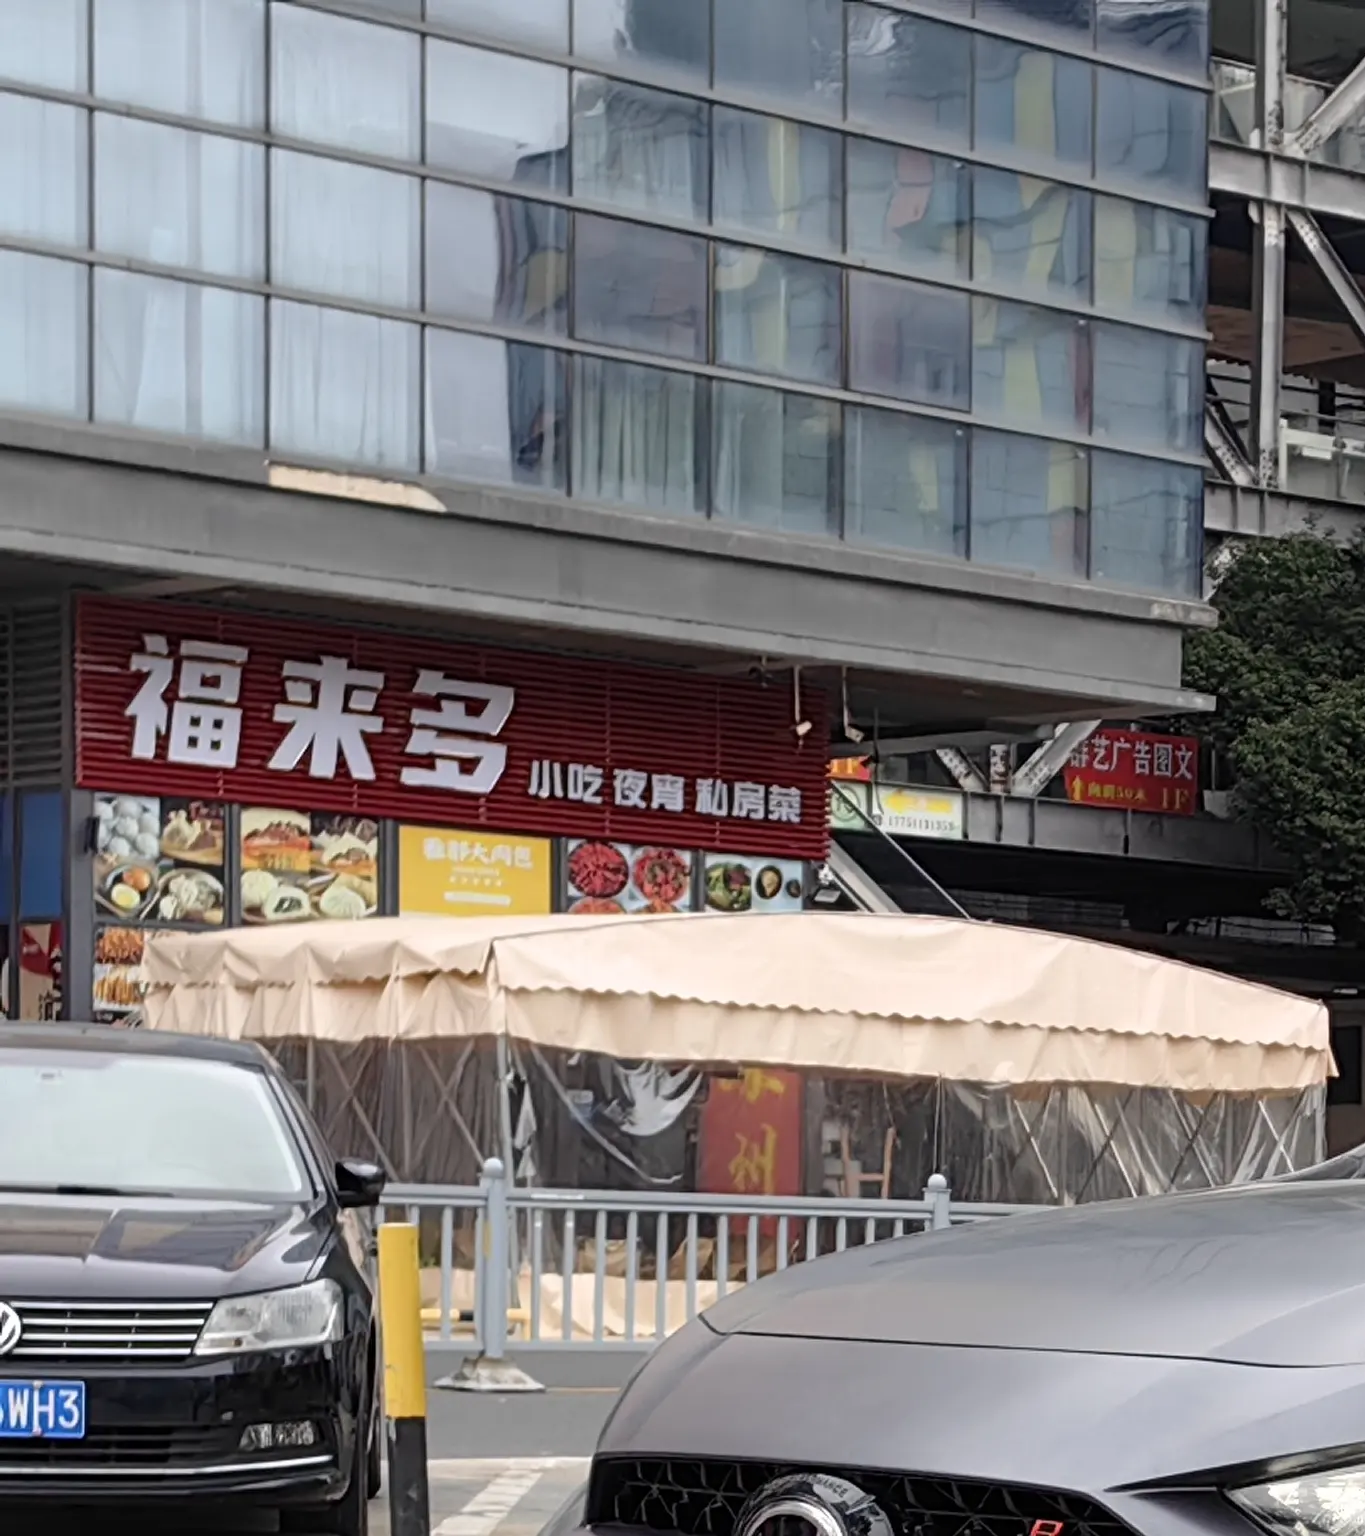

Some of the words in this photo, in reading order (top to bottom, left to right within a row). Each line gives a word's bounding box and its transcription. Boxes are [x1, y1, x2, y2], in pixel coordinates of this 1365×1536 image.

[125, 634, 515, 794] 福来多
[527, 759, 604, 803] 小吃
[613, 768, 685, 813] 夜宵
[695, 778, 801, 823] 私房菜
[0, 1388, 80, 1430] WH3
